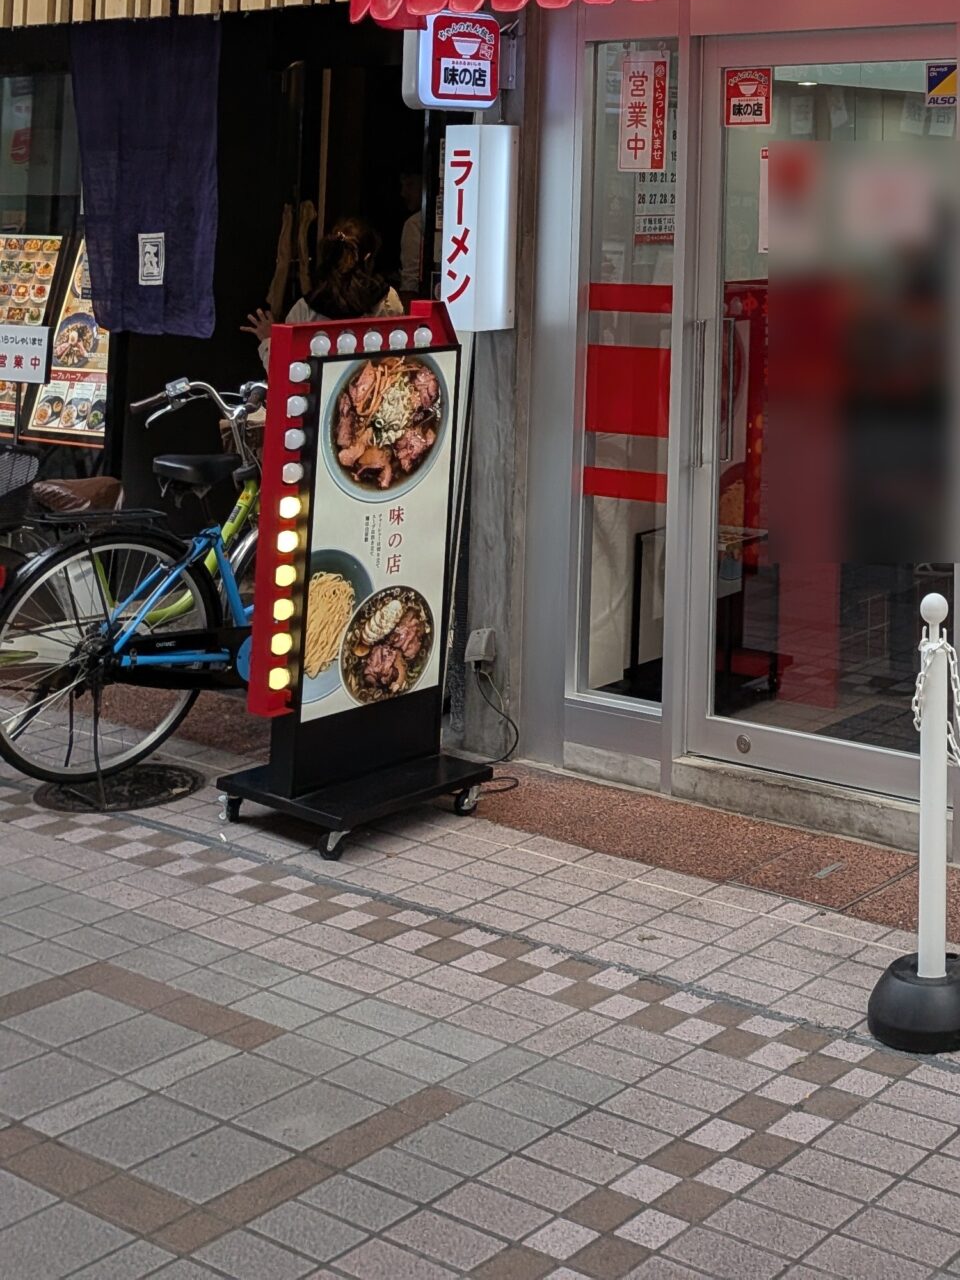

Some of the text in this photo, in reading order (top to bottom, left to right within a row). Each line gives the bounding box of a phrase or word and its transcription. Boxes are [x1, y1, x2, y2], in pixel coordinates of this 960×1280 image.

[443, 66, 487, 88] 味の店
[732, 102, 763, 117] 味の店
[928, 97, 957, 105] ALSO
[626, 70, 649, 161] 営業中
[653, 80, 665, 161] いらっしゃいませ
[447, 150, 473, 304] ラーメン
[386, 505, 404, 574] 味の店
